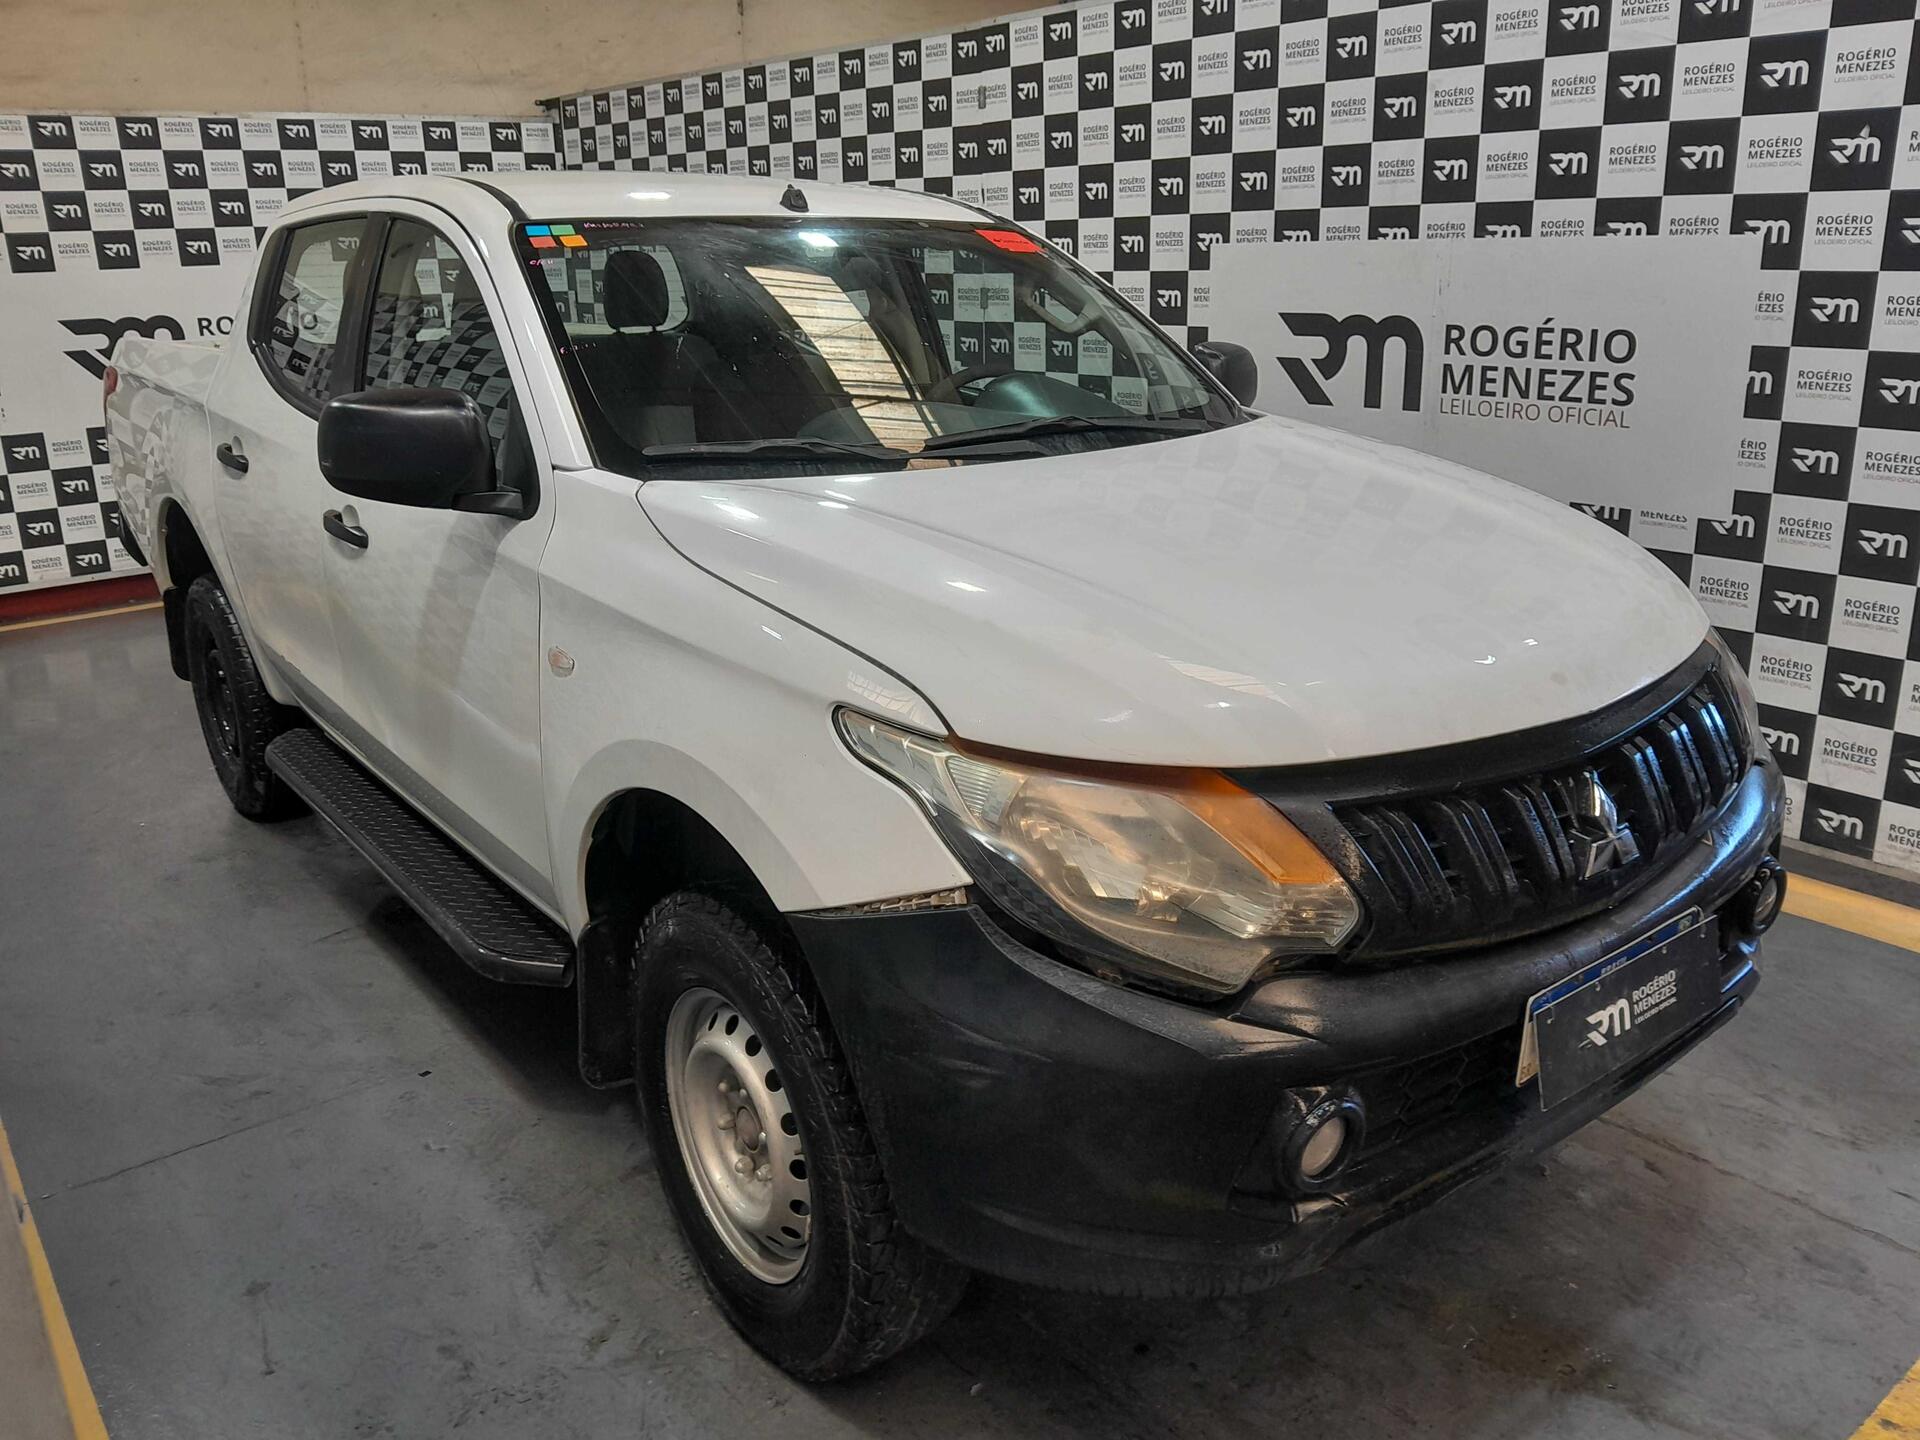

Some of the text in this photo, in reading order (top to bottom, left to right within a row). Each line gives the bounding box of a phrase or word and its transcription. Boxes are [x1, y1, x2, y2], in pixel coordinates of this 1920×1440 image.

[1496, 8, 1538, 22] ROGÉRIO
[1621, 2, 1670, 16] MENEZES
[1495, 18, 1538, 32] MENEZES
[1384, 34, 1422, 46] MENEZES
[1286, 47, 1320, 59] MENEZES
[1837, 47, 1896, 62] ROGÉRIO
[1198, 60, 1228, 71] MENEZES
[1684, 62, 1735, 76] ROGÉRIO
[1835, 59, 1895, 74] MENEZES
[1551, 74, 1596, 87] ROGÉRIO
[1683, 73, 1734, 87] MENEZES
[1551, 85, 1596, 97] MENEZES
[1434, 96, 1474, 108] MENEZES
[1330, 106, 1366, 118] MENEZES
[1239, 116, 1271, 126] MENEZES
[1749, 136, 1803, 149] ROGÉRIO
[1486, 151, 1528, 162] ROGÉRIO
[1609, 144, 1657, 156] ROGÉRIO
[1748, 148, 1802, 160] MENEZES
[1486, 161, 1528, 172] MENEZES
[1608, 154, 1656, 166] MENEZES
[1282, 174, 1315, 183] MENEZES
[1378, 168, 1415, 178] MENEZES
[1196, 179, 1226, 188] MENEZES
[1540, 216, 1585, 229] ROGÉRIO
[1669, 214, 1719, 228] ROGÉRIO
[1816, 213, 1873, 225] ROGÉRIO
[1326, 225, 1361, 236] ROGÉRIO
[1427, 222, 1466, 233] ROGÉRIO
[1815, 226, 1872, 236] MENEZES
[1444, 317, 1637, 364] ROGÉRIO
[1798, 369, 1852, 382] ROGÉRIO
[1441, 364, 1636, 406] MENEZES
[1796, 380, 1852, 392] MENEZES
[1440, 398, 1630, 428] LEILOEIRO OFICIAL
[1866, 451, 1920, 465] ROGÉRIO
[1864, 462, 1920, 476] MENEZES
[1779, 516, 1832, 531] ROGÉRIO
[1778, 526, 1832, 541] MENEZES
[1700, 576, 1749, 591] ROGÉRIO
[1699, 585, 1748, 601] MENEZES
[1845, 598, 1900, 615] ROGÉRIO
[1843, 608, 1899, 625] MENEZES
[1761, 655, 1813, 672] ROGÉRIO
[1760, 664, 1812, 682] MENEZES
[1824, 738, 1878, 757] ROGÉRIO
[1822, 747, 1877, 766] MENEZES
[1632, 970, 1676, 1002] ROGÉRIO
[1634, 982, 1677, 1015] MENEZES
